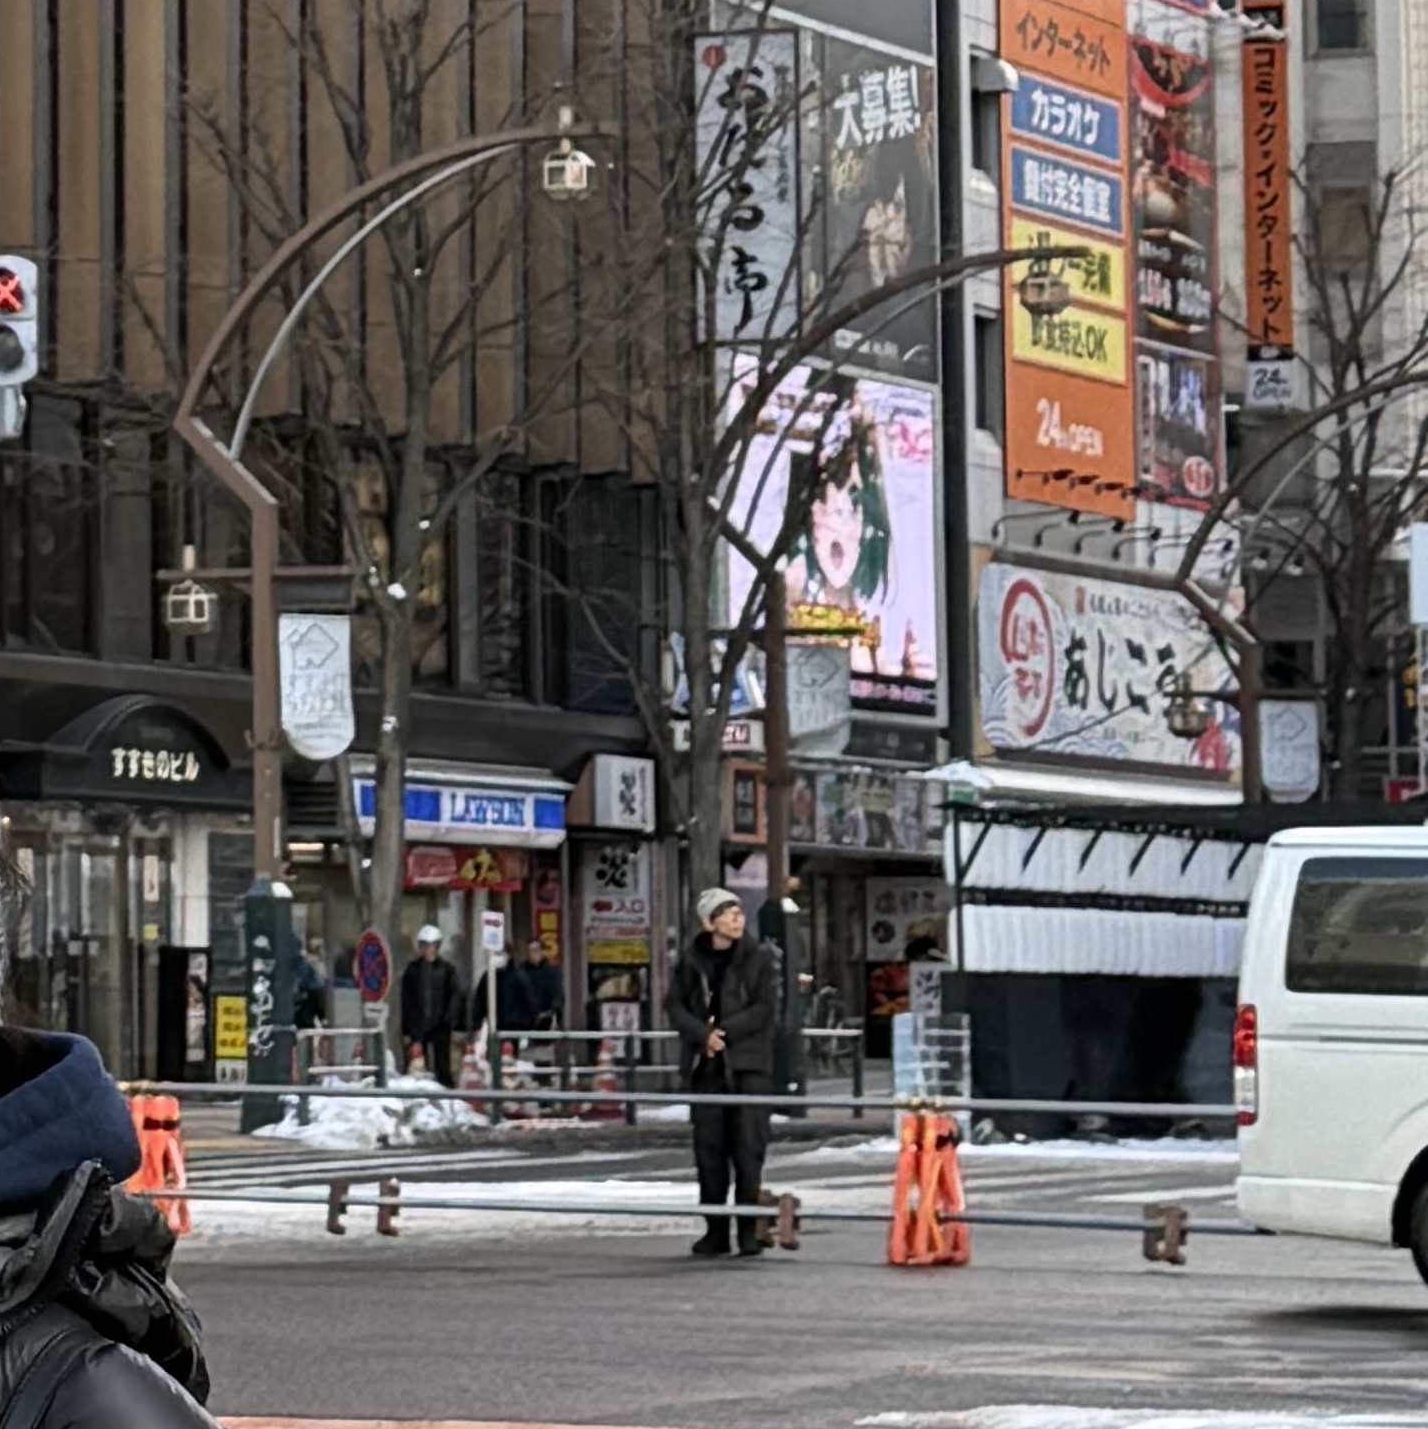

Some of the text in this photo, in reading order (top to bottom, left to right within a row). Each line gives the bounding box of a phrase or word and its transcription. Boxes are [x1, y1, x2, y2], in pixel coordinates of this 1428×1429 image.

[1016, 11, 1111, 76] インターネット
[1031, 86, 1100, 145] カラオケ
[111, 746, 201, 782] すすきのビル
[452, 792, 526, 826] LAWSON
